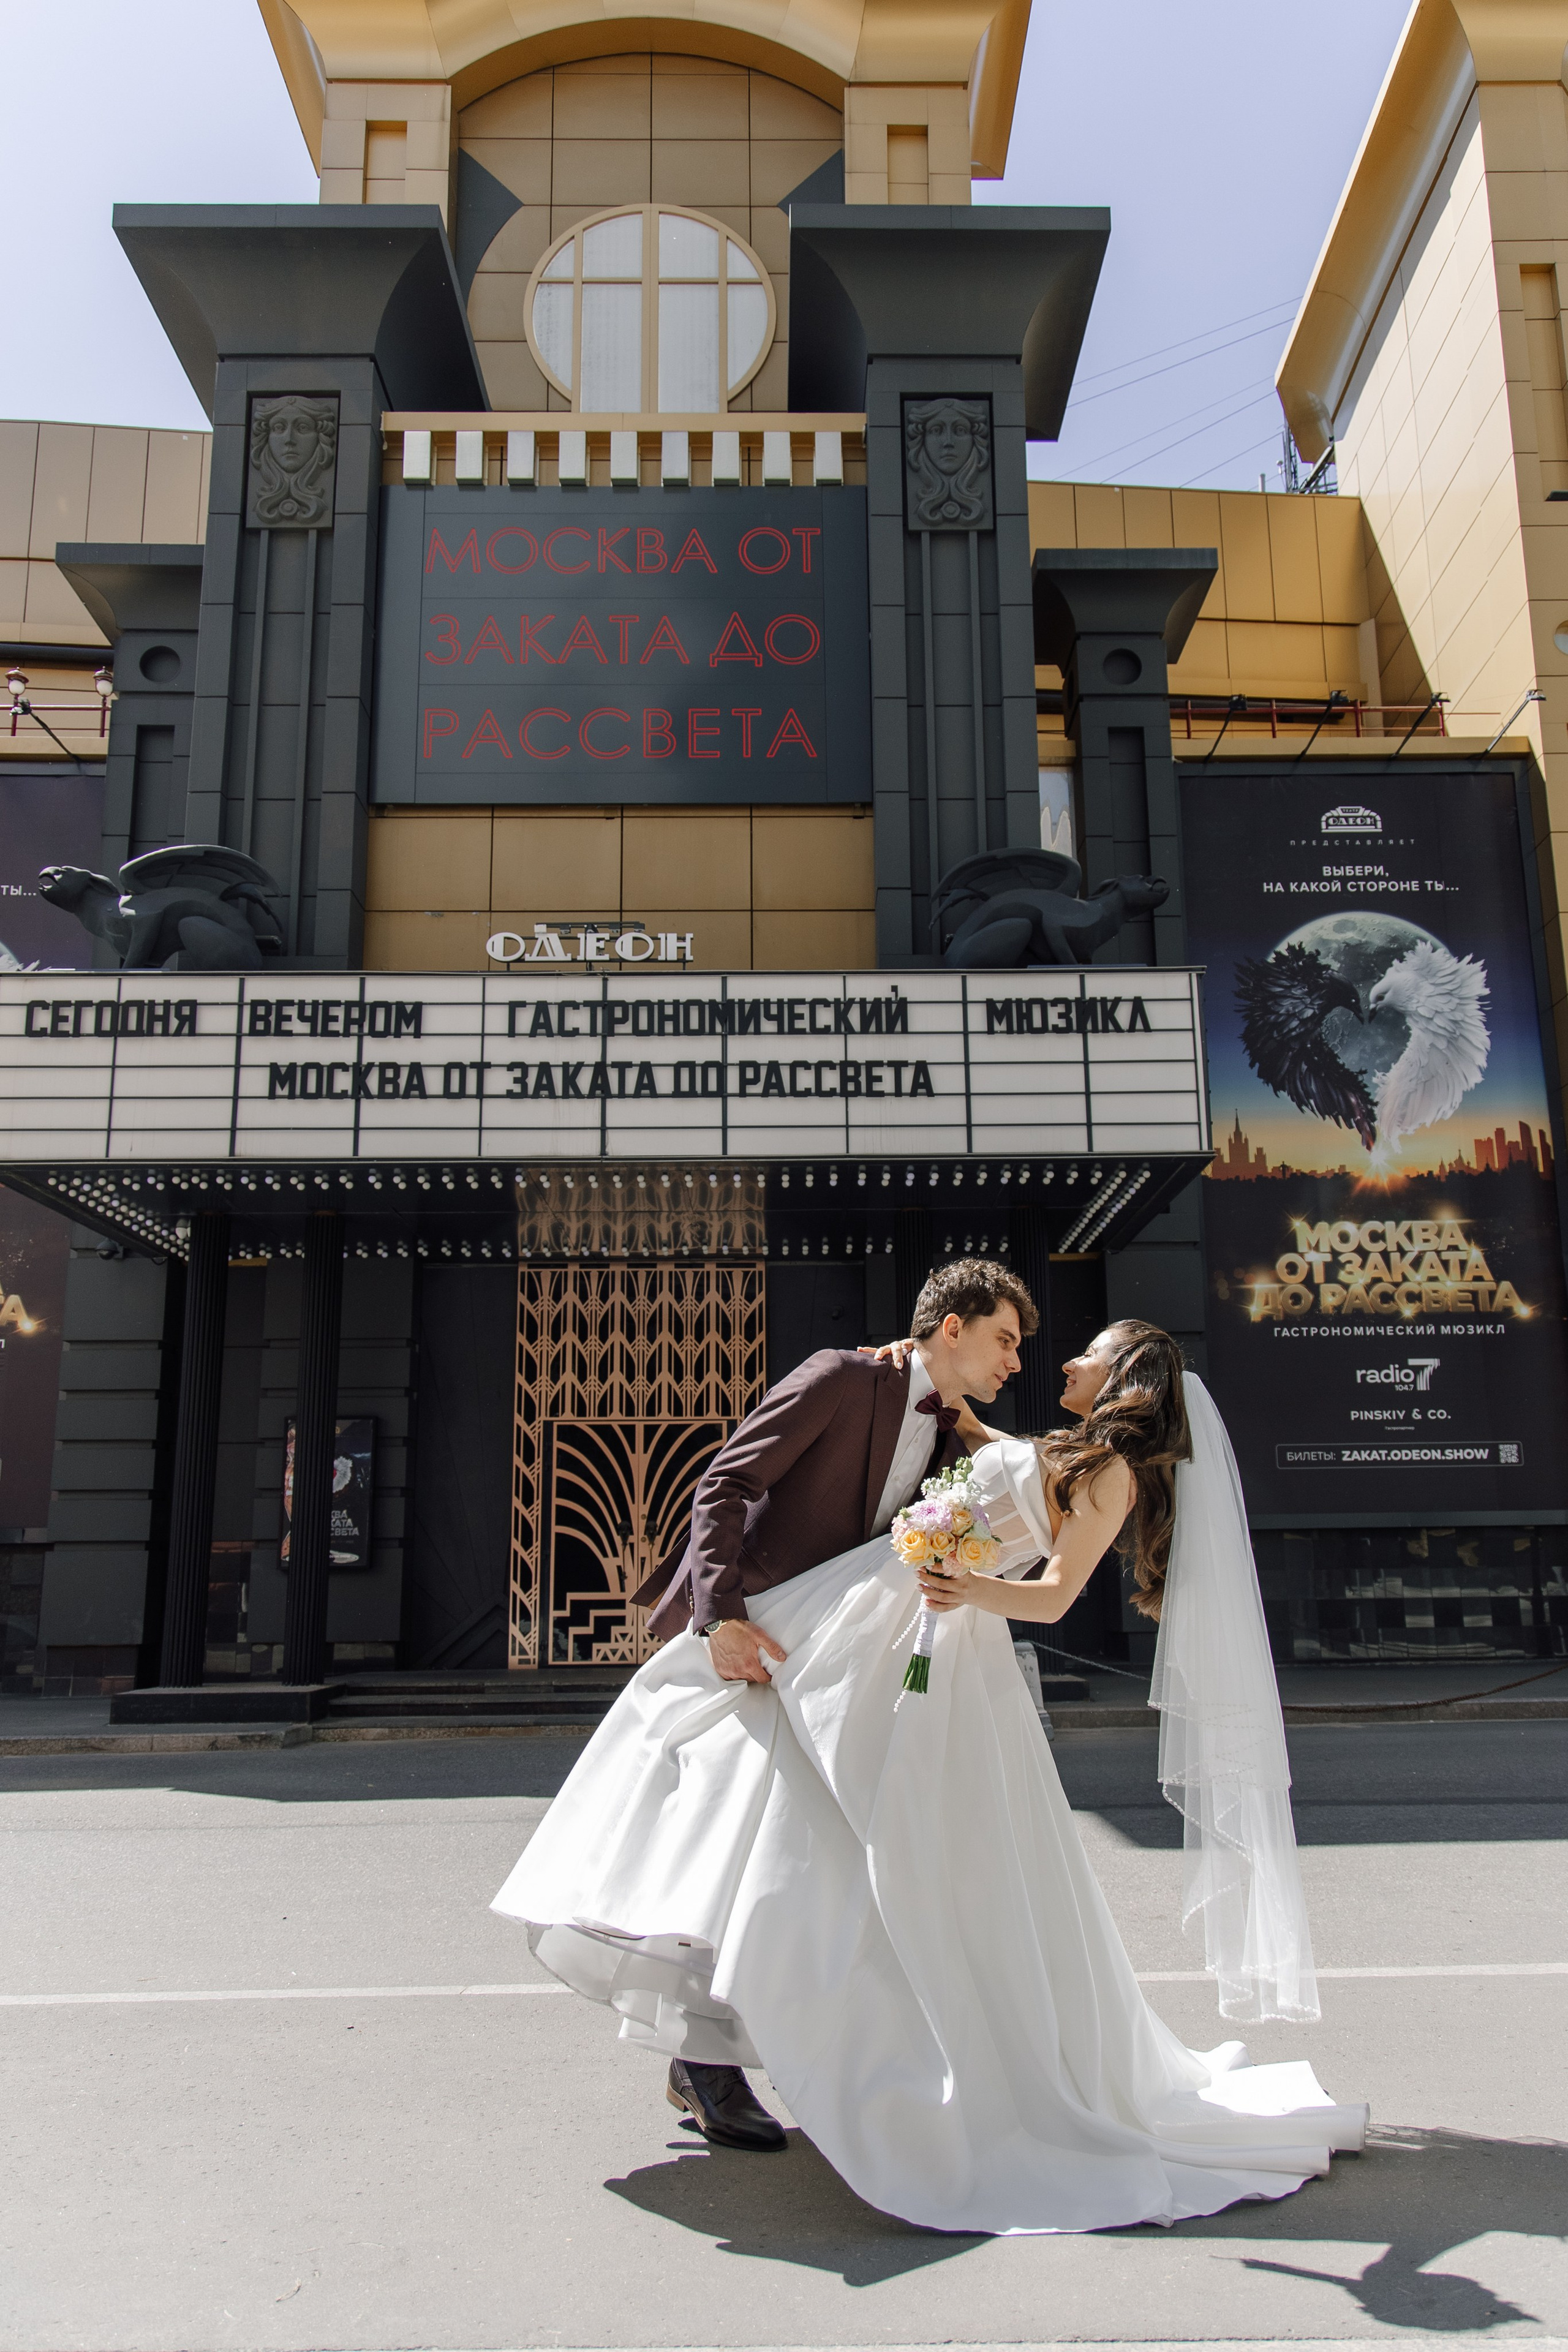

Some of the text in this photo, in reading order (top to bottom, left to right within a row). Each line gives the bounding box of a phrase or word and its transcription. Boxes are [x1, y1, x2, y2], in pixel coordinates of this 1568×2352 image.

[424, 527, 821, 575] МОСКВА ОТ
[424, 611, 821, 668] ЗАКАТА ДО
[423, 707, 818, 760] РАССВЕТА
[1327, 816, 1374, 826] ОДЕОН
[1262, 881, 1284, 893] НА
[1290, 879, 1341, 892] КАКОЙ
[1347, 881, 1420, 892] СТОРОНЕ
[1322, 865, 1389, 878] ВЫБЕРИ,
[1, 884, 37, 896] ТЫ...
[486, 932, 694, 962] ОДЕОН
[24, 985, 1153, 1039] СЕГОДНЯ ВЕЧЕРОМ ГАСТРОНОМИЧЕСКИЙ МЮЗИКЛ
[268, 1060, 935, 1099] МОСКВА ОТ ЗАКАТА ДО РАССВЕТА
[1295, 1220, 1470, 1253] МОСКВА
[1276, 1250, 1495, 1284] ОТ ЗАКАТА
[1251, 1280, 1524, 1322] ДО РАССВЕТА
[1273, 1324, 1506, 1337] ГАСТРОНОМИЧЕСКИЙ МЮЗИКЛ
[1350, 1408, 1452, 1420] PINSKIY & CO.
[1287, 1448, 1490, 1462] БИЛЕТЫ: ZAKAT.ODEON.SHOW
